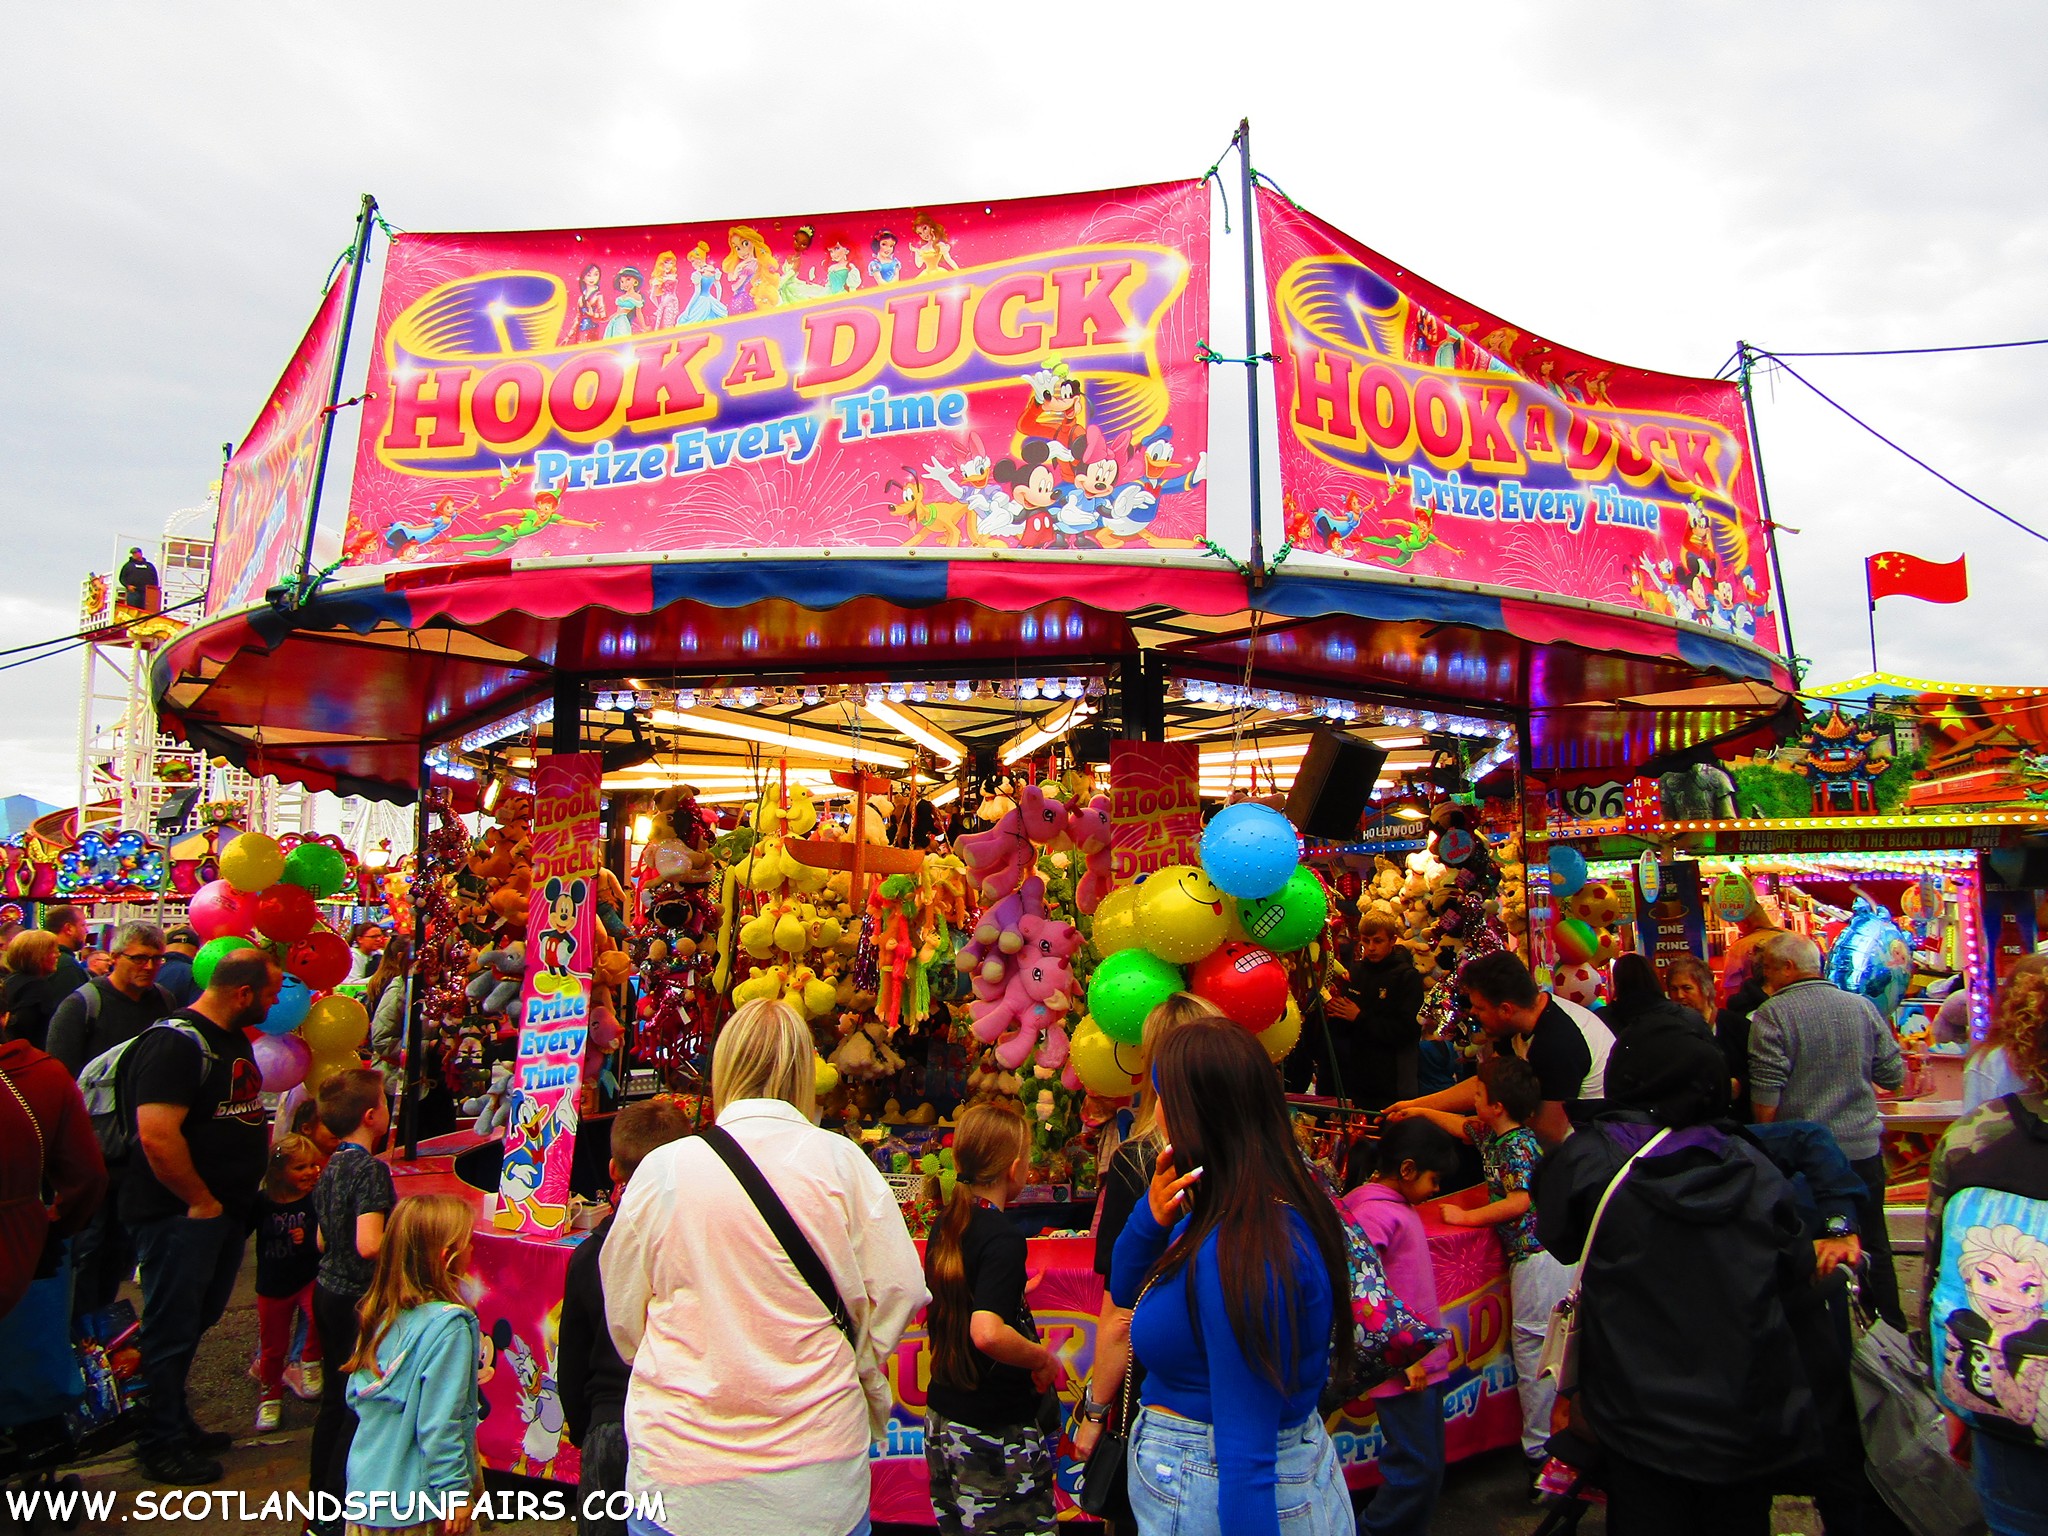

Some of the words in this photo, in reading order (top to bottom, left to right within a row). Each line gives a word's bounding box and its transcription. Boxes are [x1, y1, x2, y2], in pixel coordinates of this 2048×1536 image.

[383, 336, 710, 450] HOOK
[725, 339, 776, 387] A
[797, 262, 1132, 389] DUCK
[1296, 346, 1518, 464] HOOK
[1525, 407, 1553, 453] A
[1565, 411, 1718, 489] DUCK
[535, 444, 665, 491] Prize
[674, 416, 820, 461] Every
[835, 388, 965, 440] Time
[1411, 468, 1495, 518] Prize
[1500, 482, 1586, 532] Every
[1590, 485, 1658, 530] Time
[535, 784, 599, 828] Hook
[1113, 778, 1198, 819] Hook
[1633, 778, 1643, 818] HINA
[558, 828, 573, 847] A
[1147, 821, 1164, 842] A
[1362, 821, 1424, 841] HOLLYWOOD
[1739, 831, 1774, 842] WORLD
[1775, 834, 1798, 849] ONE
[1800, 834, 1829, 849] RING
[1831, 833, 1860, 848] OVER
[1864, 833, 1886, 848] THE
[1888, 831, 1924, 847] BLOCK
[1927, 831, 1942, 846] TO
[1944, 830, 1968, 846] WIN
[1738, 840, 1772, 852] GAMES
[533, 843, 595, 883] Duck
[1114, 837, 1198, 880] Duck
[1720, 886, 1745, 902] £2
[1729, 902, 1745, 910] PLAY
[1657, 924, 1684, 935] ONE
[2002, 914, 2017, 923] TO
[1656, 941, 1690, 951] RING
[2002, 945, 2021, 954] THE
[527, 991, 585, 1024] Prize
[520, 1029, 588, 1056] Every
[522, 1062, 579, 1092] Time
